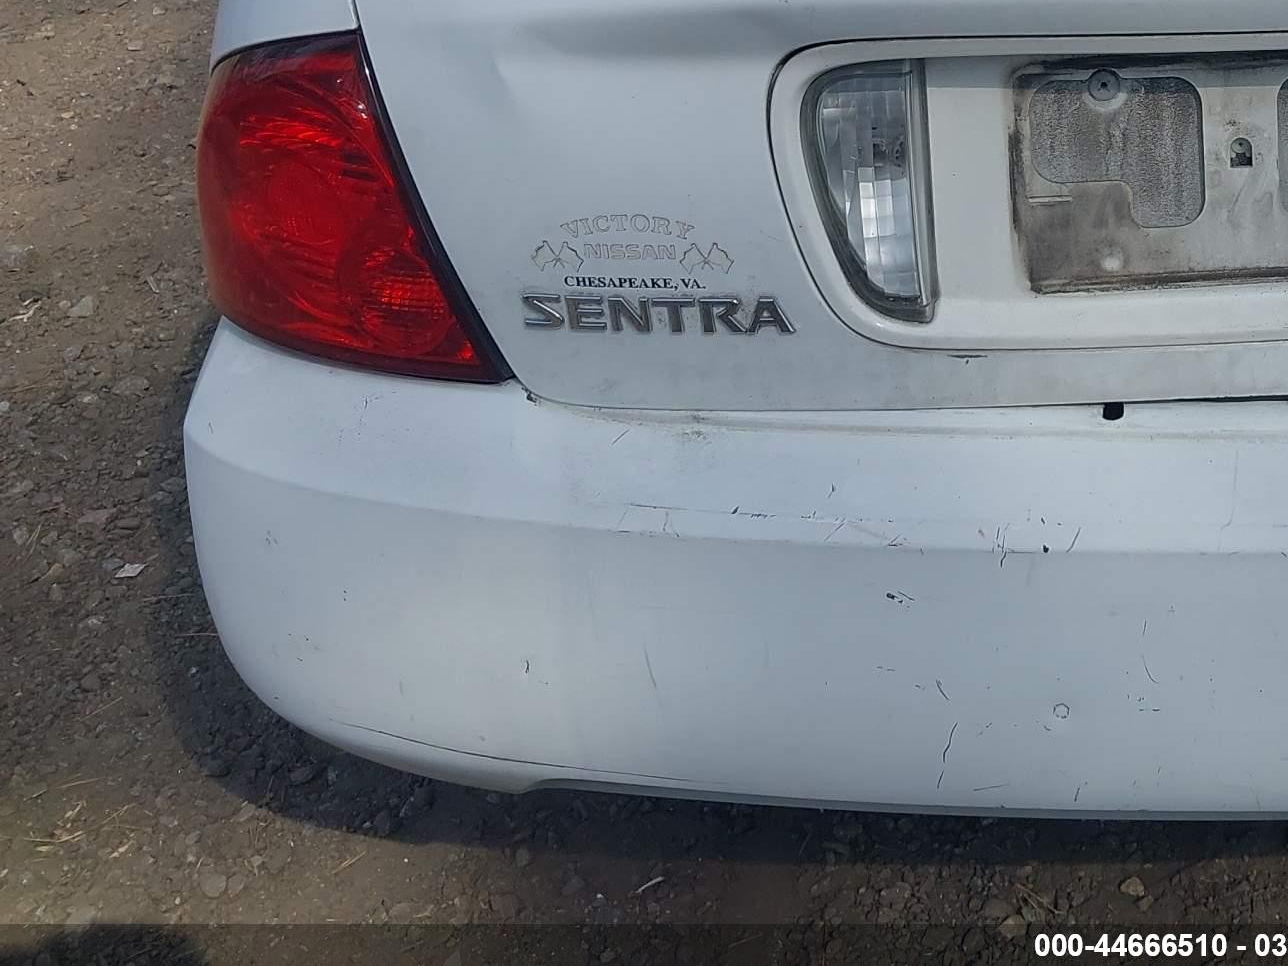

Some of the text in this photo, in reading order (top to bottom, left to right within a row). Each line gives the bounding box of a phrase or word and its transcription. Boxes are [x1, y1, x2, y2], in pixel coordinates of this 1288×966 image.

[560, 213, 696, 240] VICTORY
[583, 243, 677, 260] NISSAN
[563, 275, 706, 291] CHESAPEAKE, VA.
[521, 294, 796, 335] SENTRA
